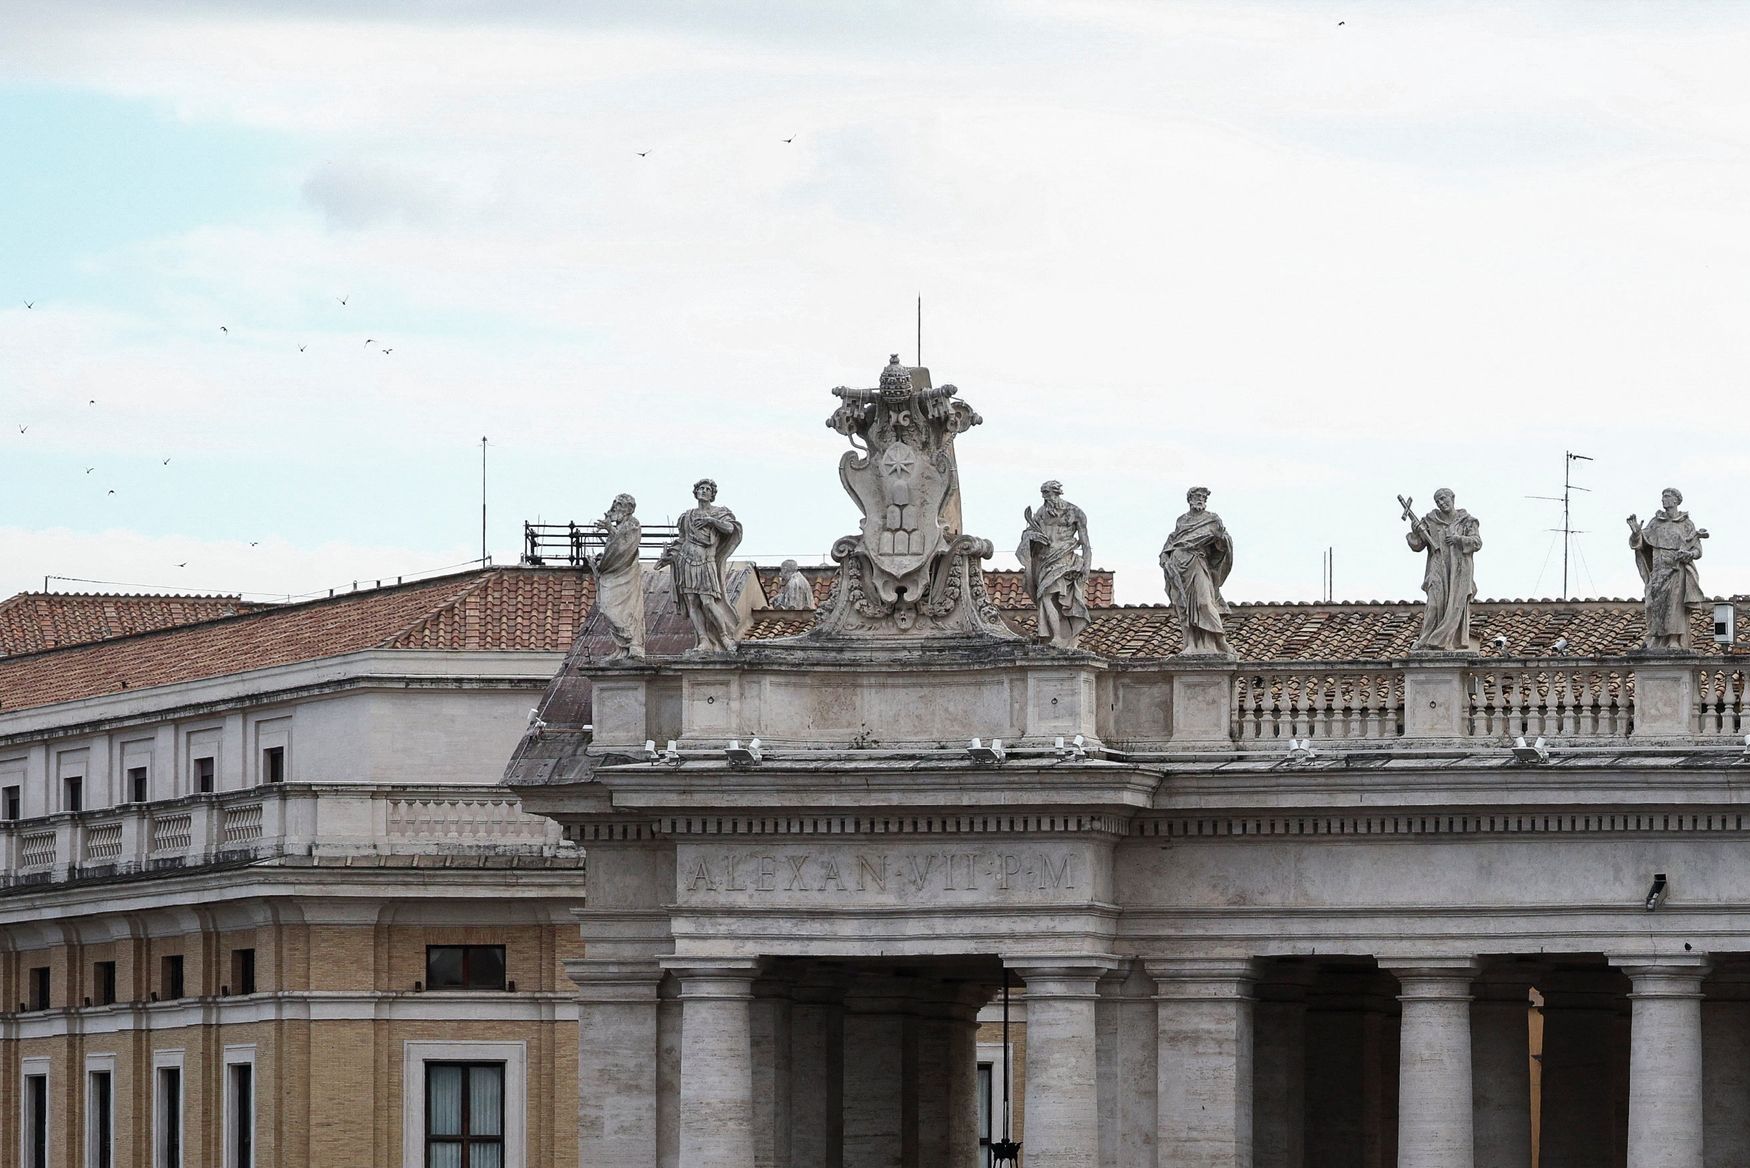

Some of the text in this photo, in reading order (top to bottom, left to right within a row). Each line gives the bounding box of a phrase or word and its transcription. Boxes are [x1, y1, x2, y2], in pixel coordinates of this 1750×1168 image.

[687, 852, 1076, 891] ALEXAN VII P M
